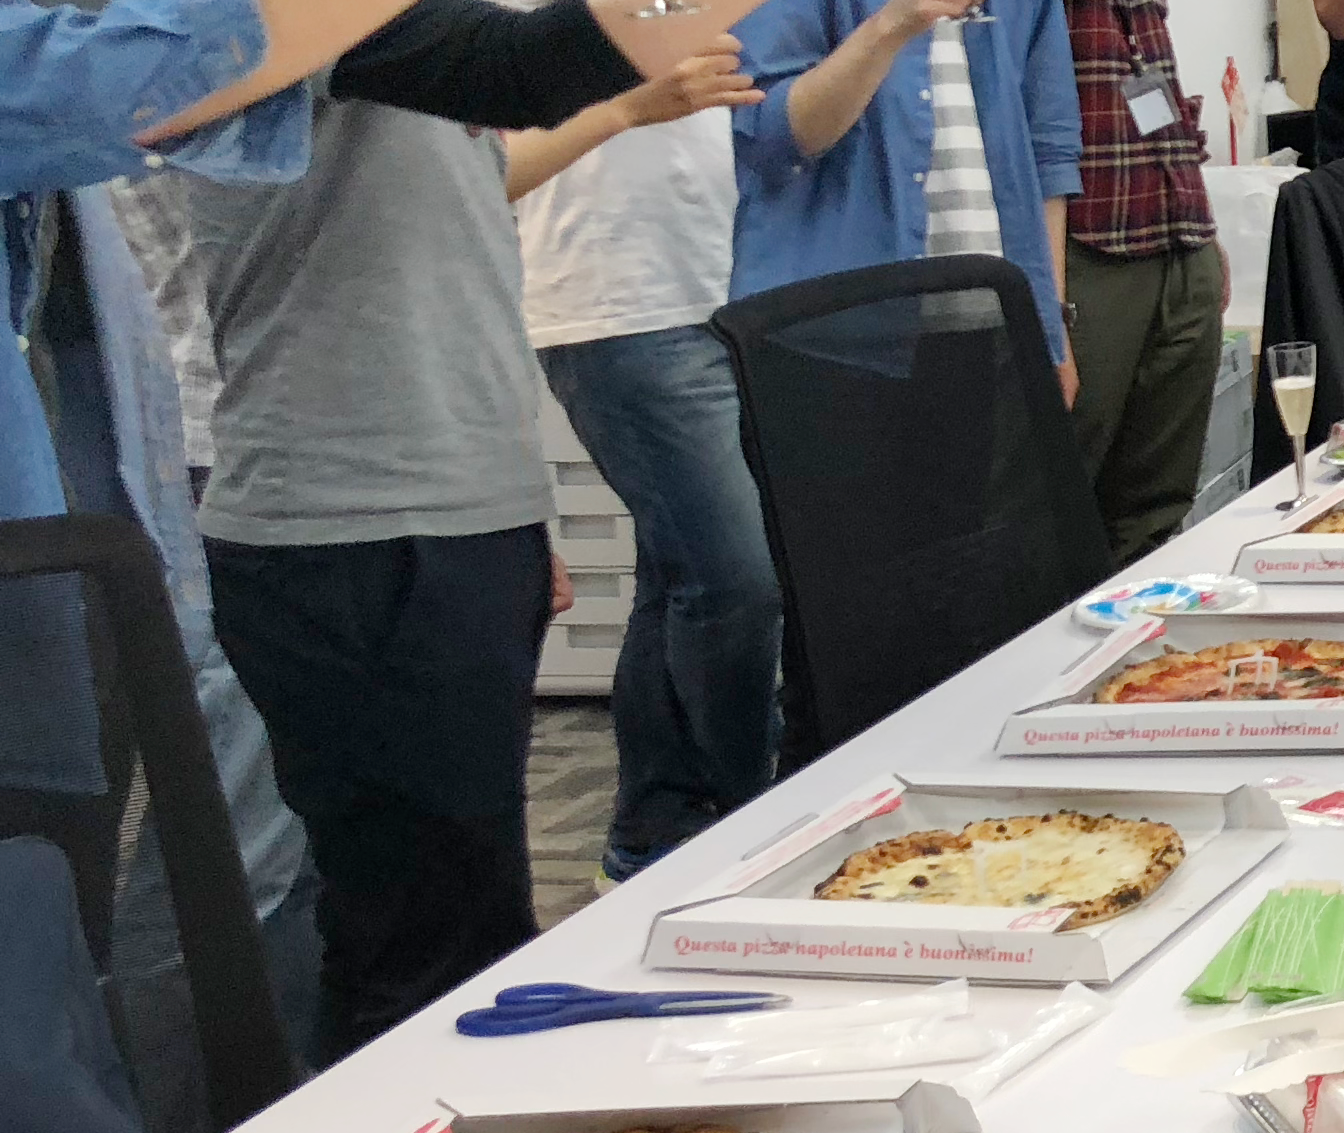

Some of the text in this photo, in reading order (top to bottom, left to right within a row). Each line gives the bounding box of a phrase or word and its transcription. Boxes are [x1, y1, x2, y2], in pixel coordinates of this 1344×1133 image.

[1254, 559, 1299, 574] Questa
[1023, 727, 1080, 746] Questa
[1130, 724, 1221, 743] napoletana
[1239, 721, 1340, 738] buonissima!
[674, 934, 738, 957] Questa
[795, 940, 898, 960] napoletana
[919, 942, 1035, 965] buonissima!
